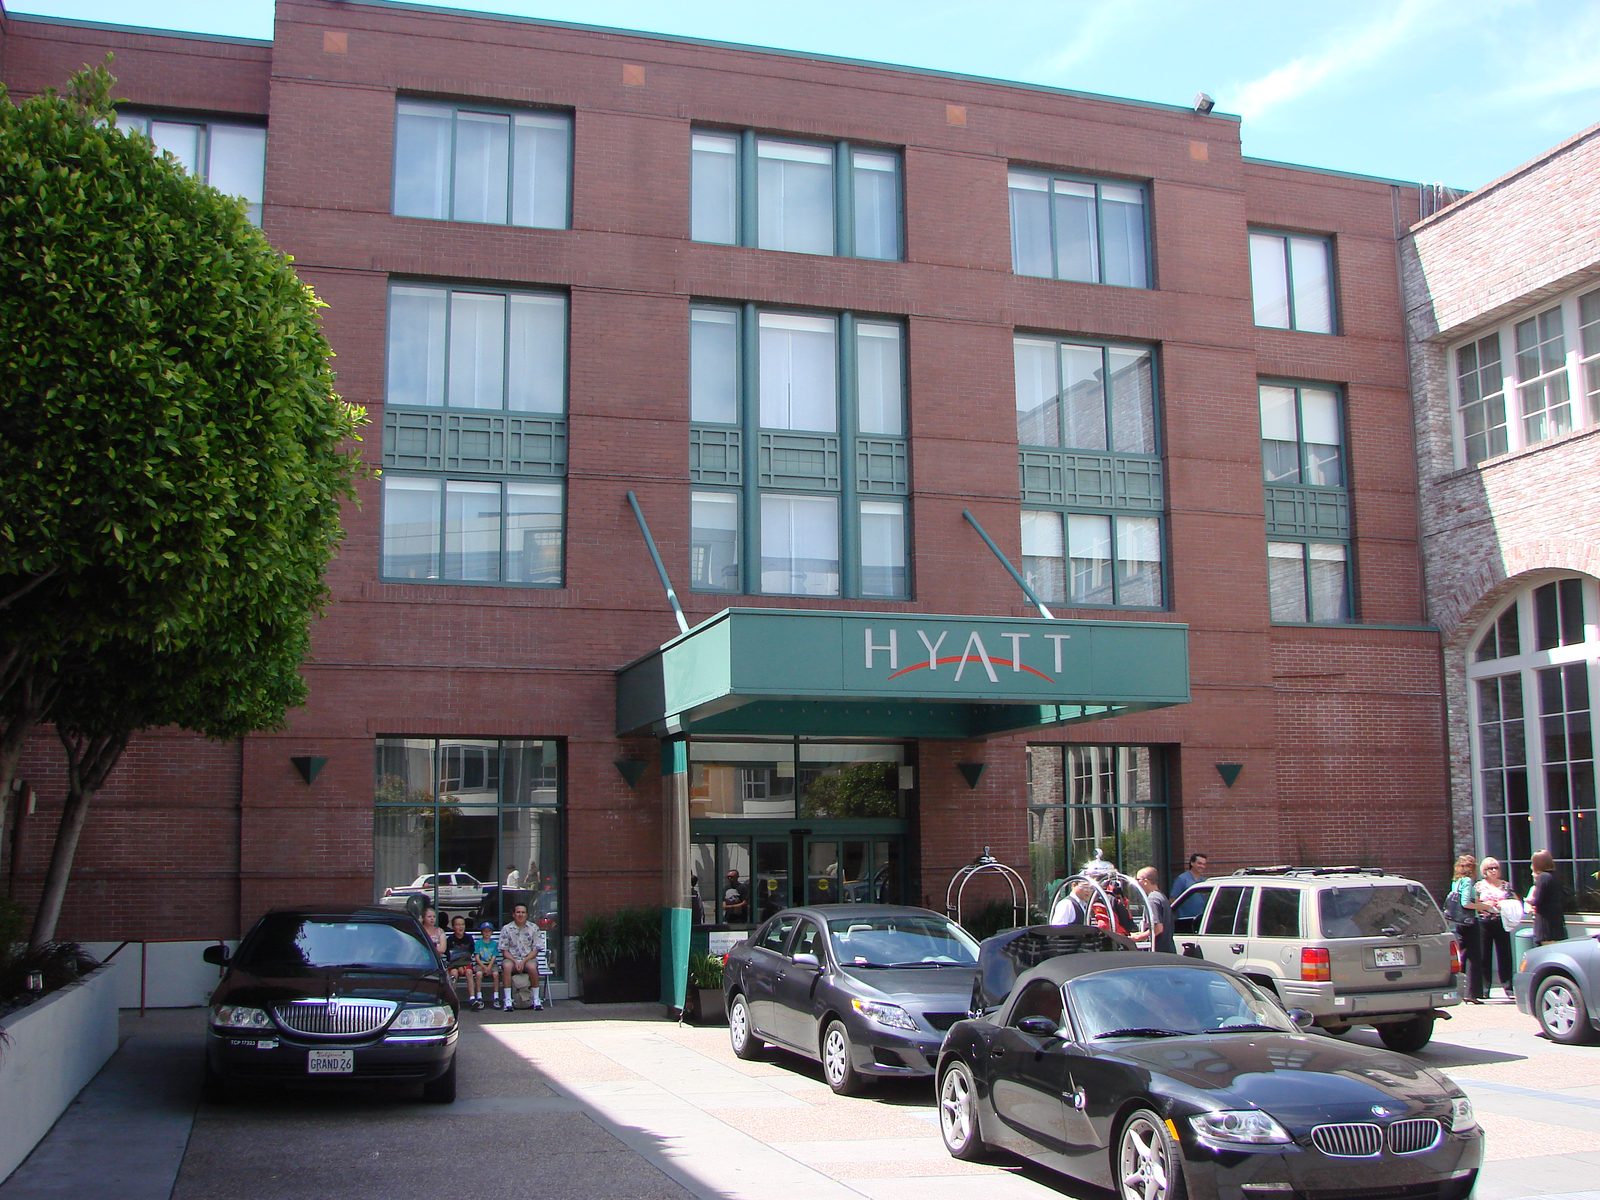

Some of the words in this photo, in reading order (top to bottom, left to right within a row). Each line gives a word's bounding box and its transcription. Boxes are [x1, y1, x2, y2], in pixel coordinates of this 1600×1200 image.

[865, 628, 1071, 682] HYATT
[311, 1058, 339, 1069] GRAND
[340, 1058, 352, 1069] 26
